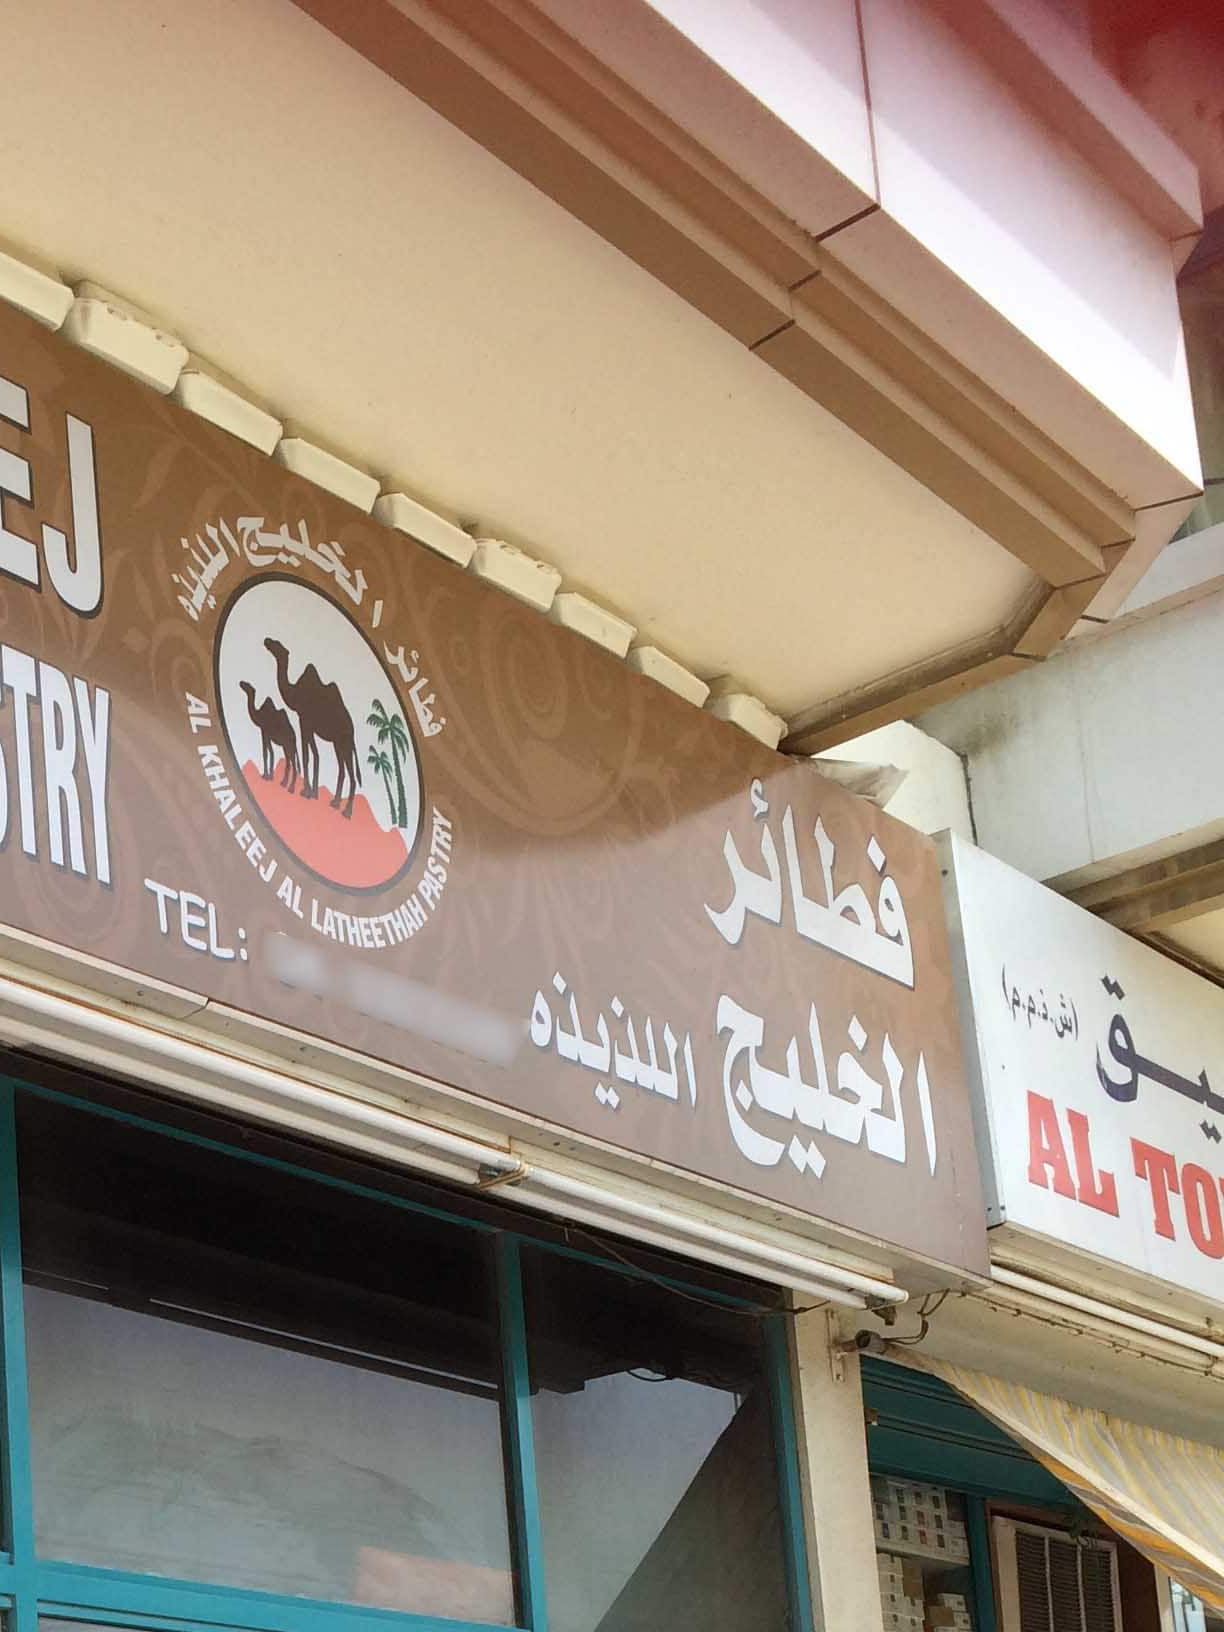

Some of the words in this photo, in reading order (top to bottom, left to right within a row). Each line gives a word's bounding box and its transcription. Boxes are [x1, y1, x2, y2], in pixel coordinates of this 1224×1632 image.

[184, 691, 212, 735] AL
[197, 744, 278, 883] KHALEEJ
[417, 806, 453, 912] PASTRY
[144, 878, 249, 961] TEL:
[276, 875, 304, 920] AL
[311, 893, 428, 949] LATHEETHAH
[704, 777, 916, 990] فطائر
[716, 993, 937, 1180] الخليج
[1026, 1089, 1120, 1218] AL
[1129, 1136, 1224, 1260] TO
